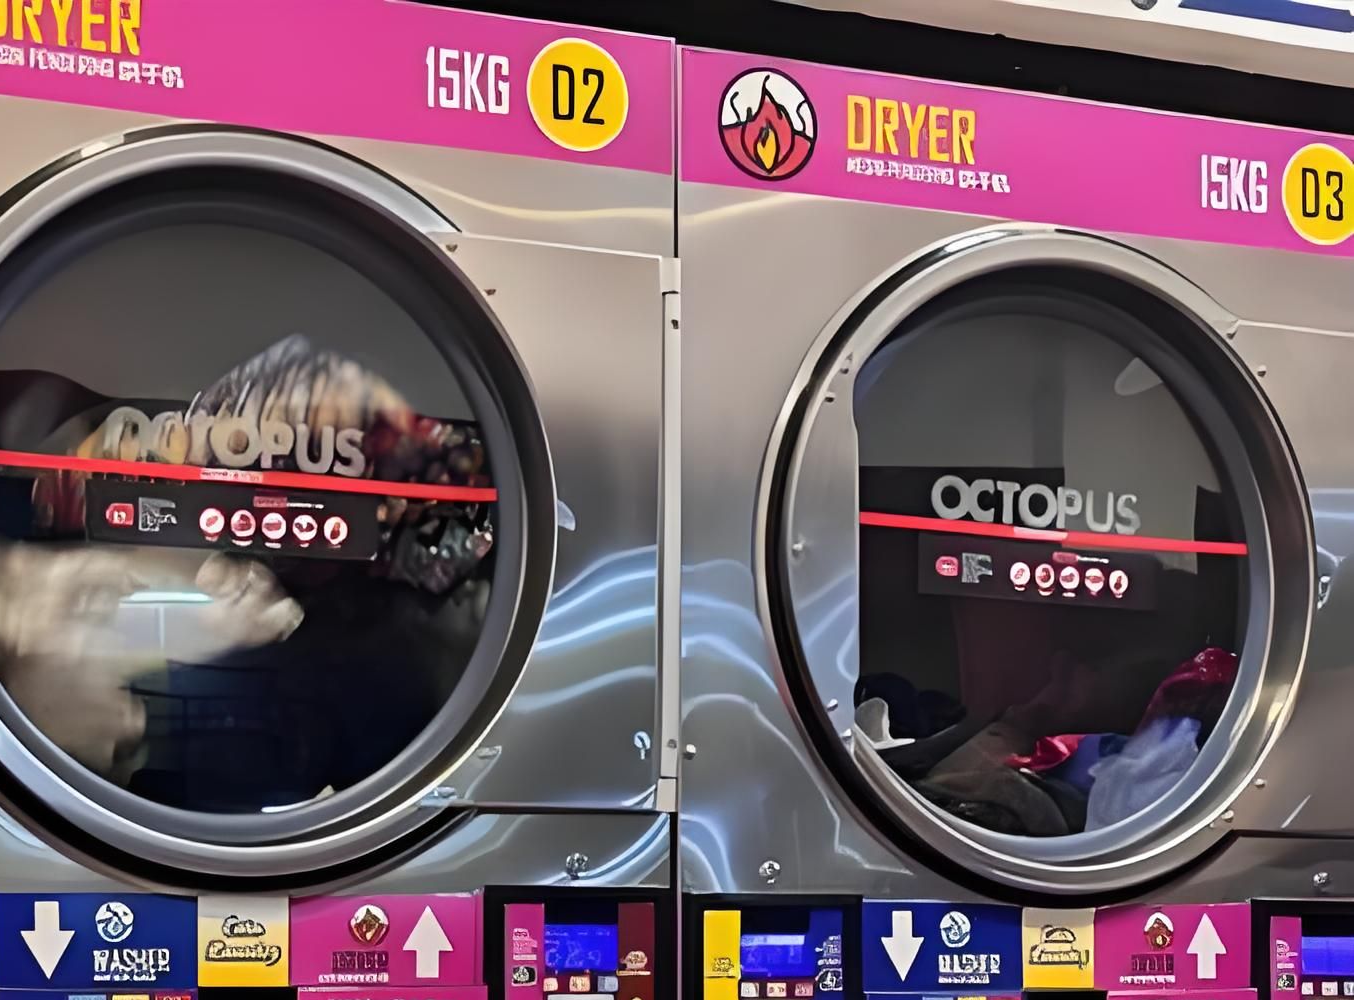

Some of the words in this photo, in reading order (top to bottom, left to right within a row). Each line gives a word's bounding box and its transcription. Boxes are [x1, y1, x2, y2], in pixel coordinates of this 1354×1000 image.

[426, 46, 510, 114] 15KG
[552, 64, 605, 125] D2
[847, 95, 975, 164] DRYER
[1201, 154, 1268, 213] 15KG
[1302, 167, 1344, 221] D3
[931, 474, 1141, 535] OCTOPUS
